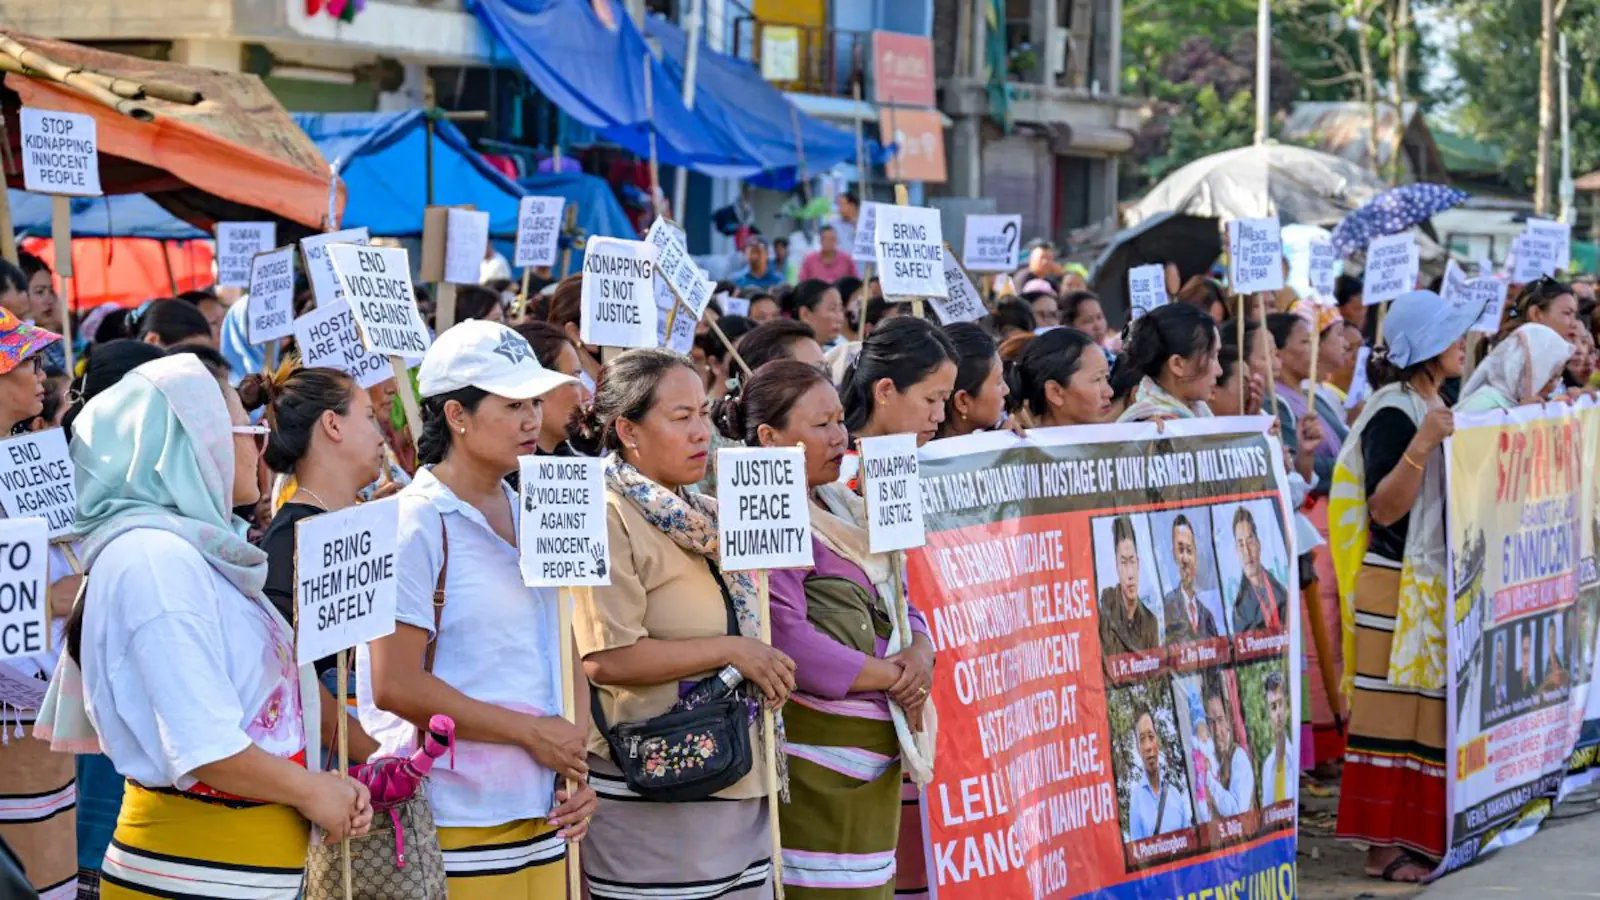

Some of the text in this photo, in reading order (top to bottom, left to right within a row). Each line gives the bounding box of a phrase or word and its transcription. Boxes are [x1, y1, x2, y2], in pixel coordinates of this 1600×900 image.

[42, 117, 73, 135] STOP
[25, 134, 93, 154] KIDNAPPING
[32, 151, 88, 170] INNOCENT
[40, 169, 85, 186] PEOPLE
[531, 201, 545, 214] END
[229, 229, 261, 239] HUMAN
[893, 223, 926, 241] BRING
[1002, 221, 1018, 265] ?
[229, 242, 260, 253] RIGHTS
[880, 241, 911, 259] THEM
[914, 243, 942, 261] HOME
[257, 259, 288, 279] HOSTAGES
[357, 250, 386, 273] END
[584, 253, 651, 279] KIDNAPPING
[894, 261, 932, 279] SAFELY
[252, 282, 263, 297] ARE
[345, 275, 410, 302] VIOLENCE
[599, 279, 634, 301] IS NOT
[264, 295, 277, 311] NOT
[359, 302, 413, 327] AGAINST
[596, 302, 641, 325] JUSTICE
[255, 310, 286, 331] WEAPONS
[308, 309, 355, 343] HOSTA
[307, 329, 360, 364] ARE HU
[368, 326, 426, 352] CIVILIANS
[7, 442, 41, 465] END
[0, 460, 71, 491] VIOLENCE
[539, 463, 587, 481] NO MORE
[732, 459, 794, 487] JUSTICE
[866, 454, 917, 480] KIDNAPPING
[942, 471, 980, 511] NAGA
[976, 464, 1026, 506] CIVILIANS
[1025, 463, 1040, 499] IN
[1041, 459, 1097, 497] HOSTAGE
[1097, 457, 1114, 492] OF
[1115, 456, 1146, 491] KUKI
[1147, 452, 1196, 487] ARMED
[1196, 445, 1268, 483] MILITANTS
[15, 482, 75, 514] AGAINST
[537, 487, 590, 505] VIOLENCE
[879, 479, 907, 502] IS NOT
[739, 493, 790, 521] PEACE
[878, 502, 913, 528] JUSTICE
[540, 512, 586, 529] AGAINST
[323, 530, 372, 568] BRING
[536, 537, 590, 554] INNOCENT
[725, 527, 805, 557] HUMANITY
[302, 553, 393, 606] THEM HOME
[543, 561, 587, 578] PEOPLE
[318, 588, 376, 631] SAFELY
[1031, 579, 1092, 626] RELEASE
[978, 650, 1002, 699] THE
[1061, 684, 1077, 727] AT
[1049, 782, 1115, 837] MANIPUR
[1249, 862, 1297, 900] UNIO
